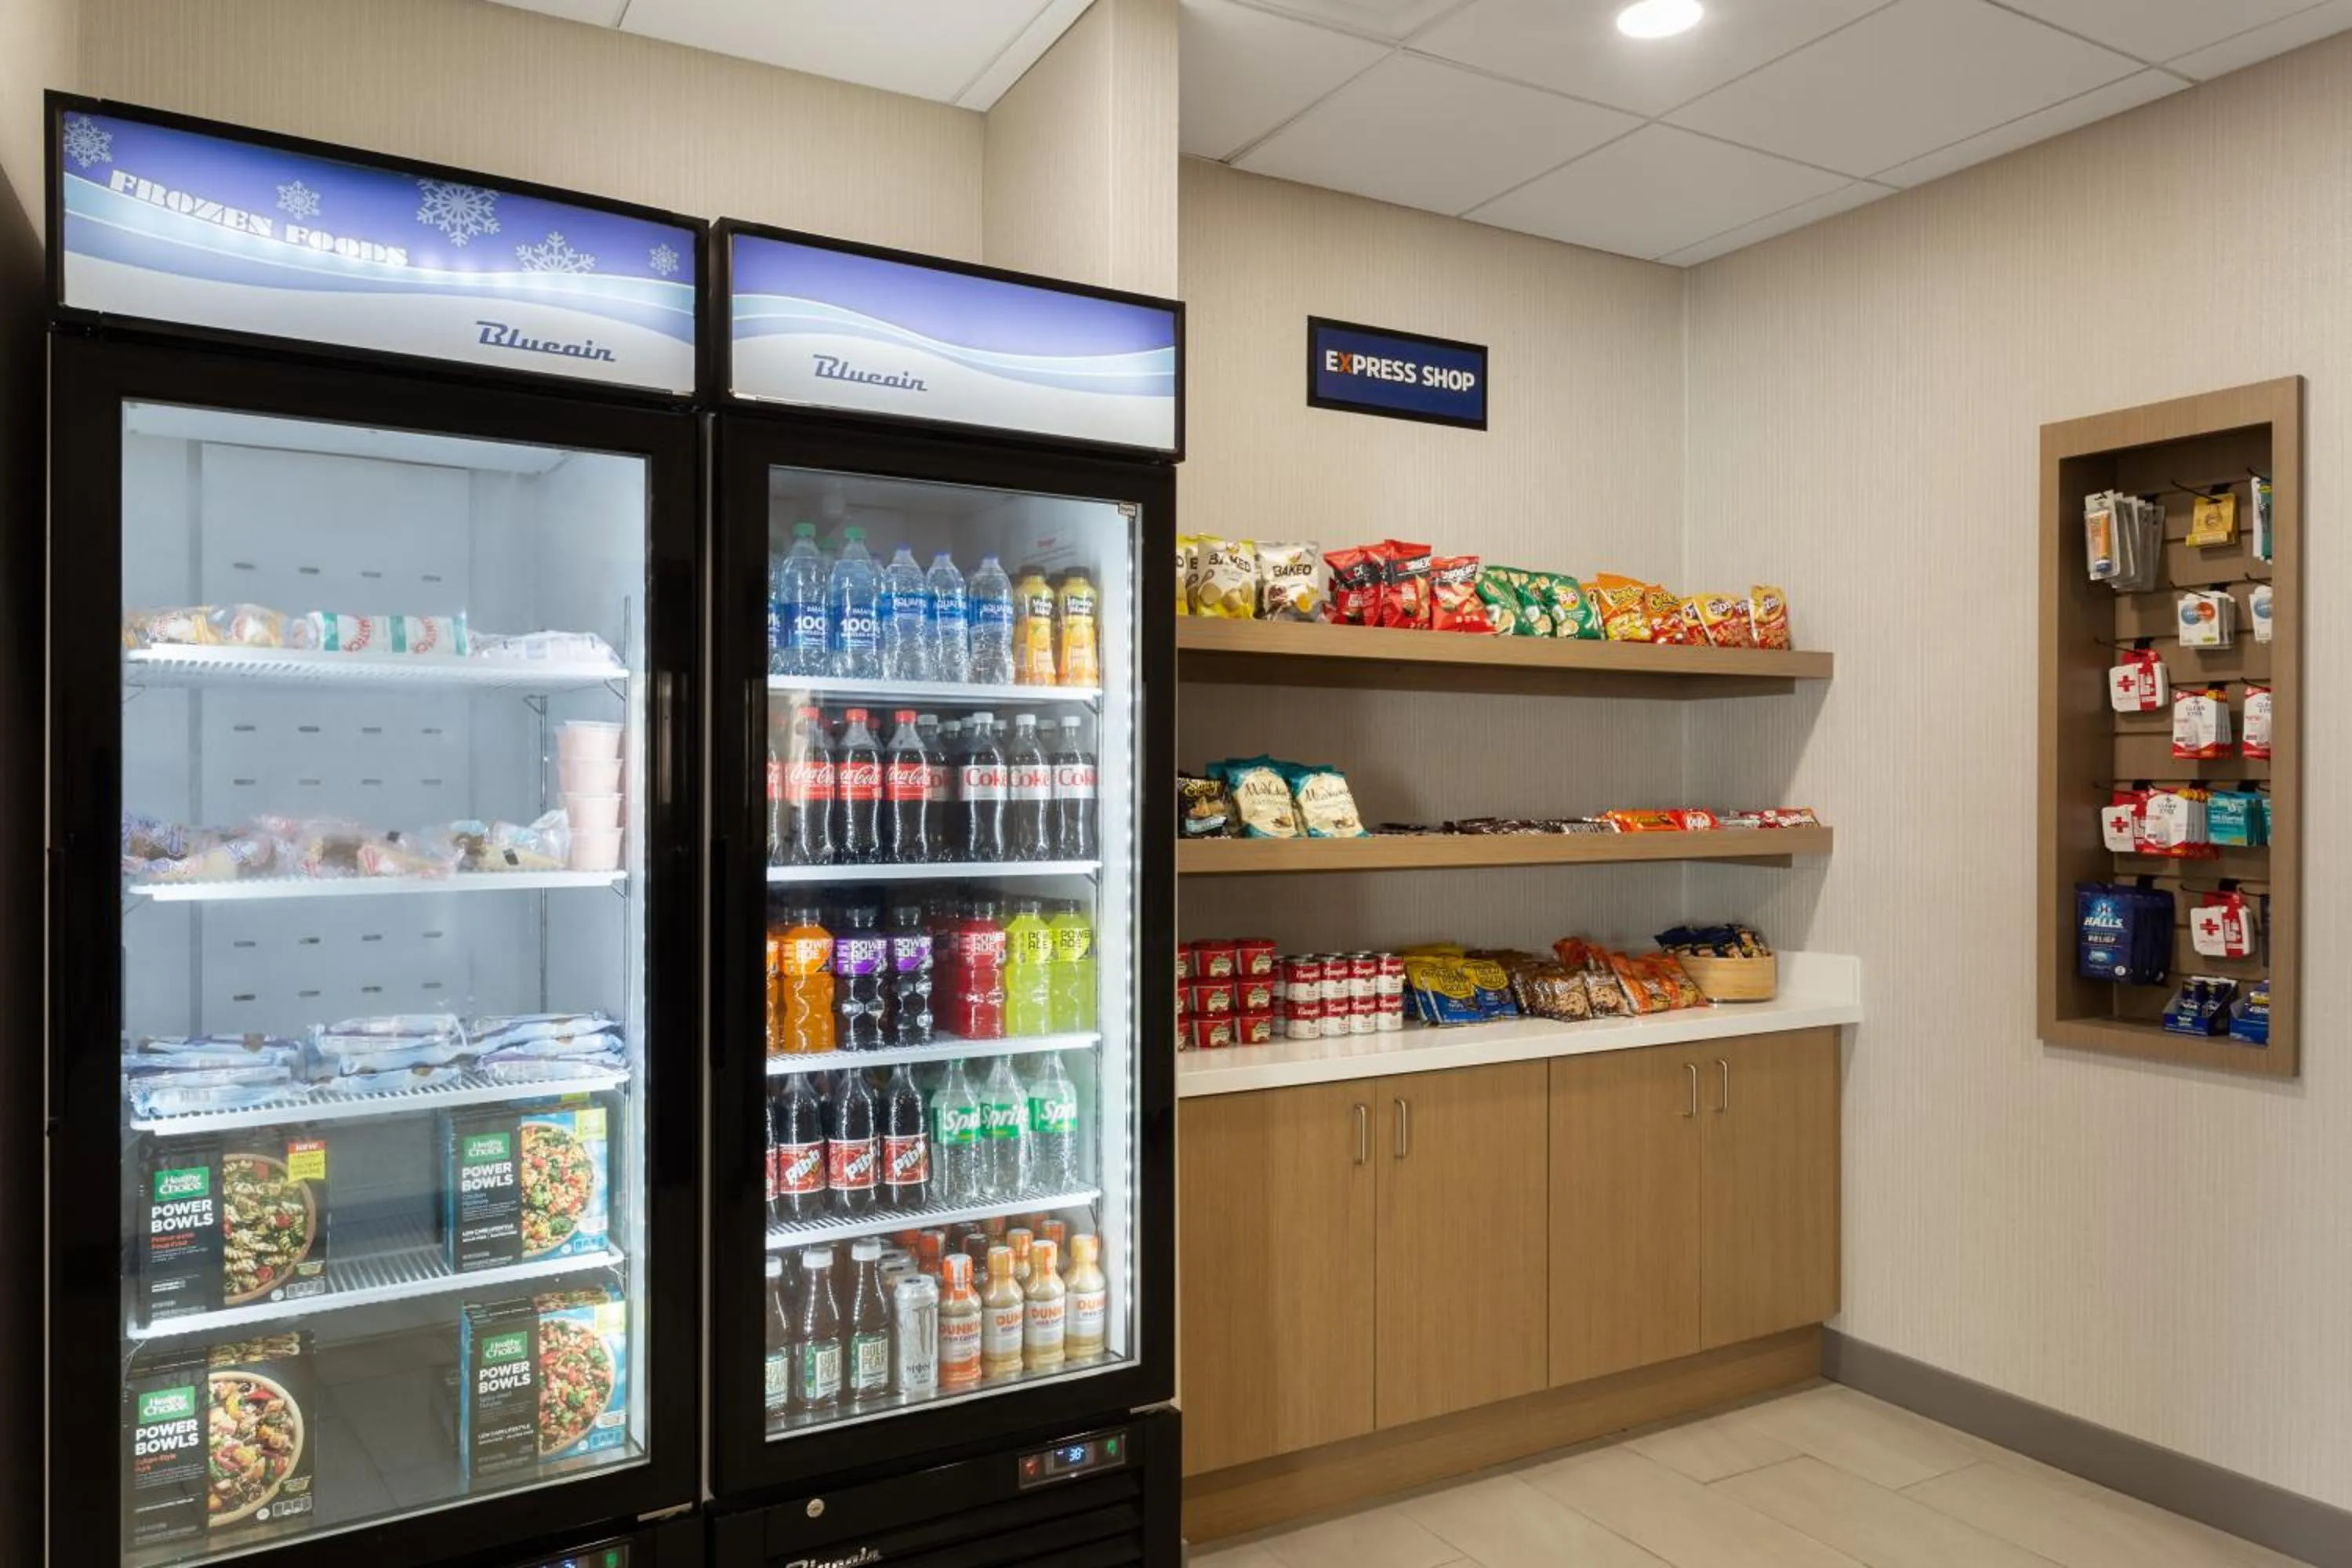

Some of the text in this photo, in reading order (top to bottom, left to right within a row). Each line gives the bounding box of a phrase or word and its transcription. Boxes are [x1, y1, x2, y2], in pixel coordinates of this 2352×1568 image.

[109, 169, 408, 267] FROZEN FOODS
[1326, 350, 1475, 391] EXPRESS SHOP
[1272, 564, 1312, 578] BAKED
[794, 615, 826, 630] 100
[1058, 767, 1094, 787] Cok
[2083, 916, 2124, 928] HALLS
[1060, 929, 1091, 939] POWE
[462, 1161, 512, 1178] POWER
[462, 1174, 514, 1192] BOWLS
[151, 1200, 212, 1219] POWER
[151, 1213, 214, 1233] BOWLS
[996, 1311, 1023, 1327] DUN
[479, 1360, 531, 1381] POWER
[478, 1373, 531, 1394] BOWLS
[136, 1419, 198, 1441] POWER
[135, 1432, 199, 1456] BOWLS
